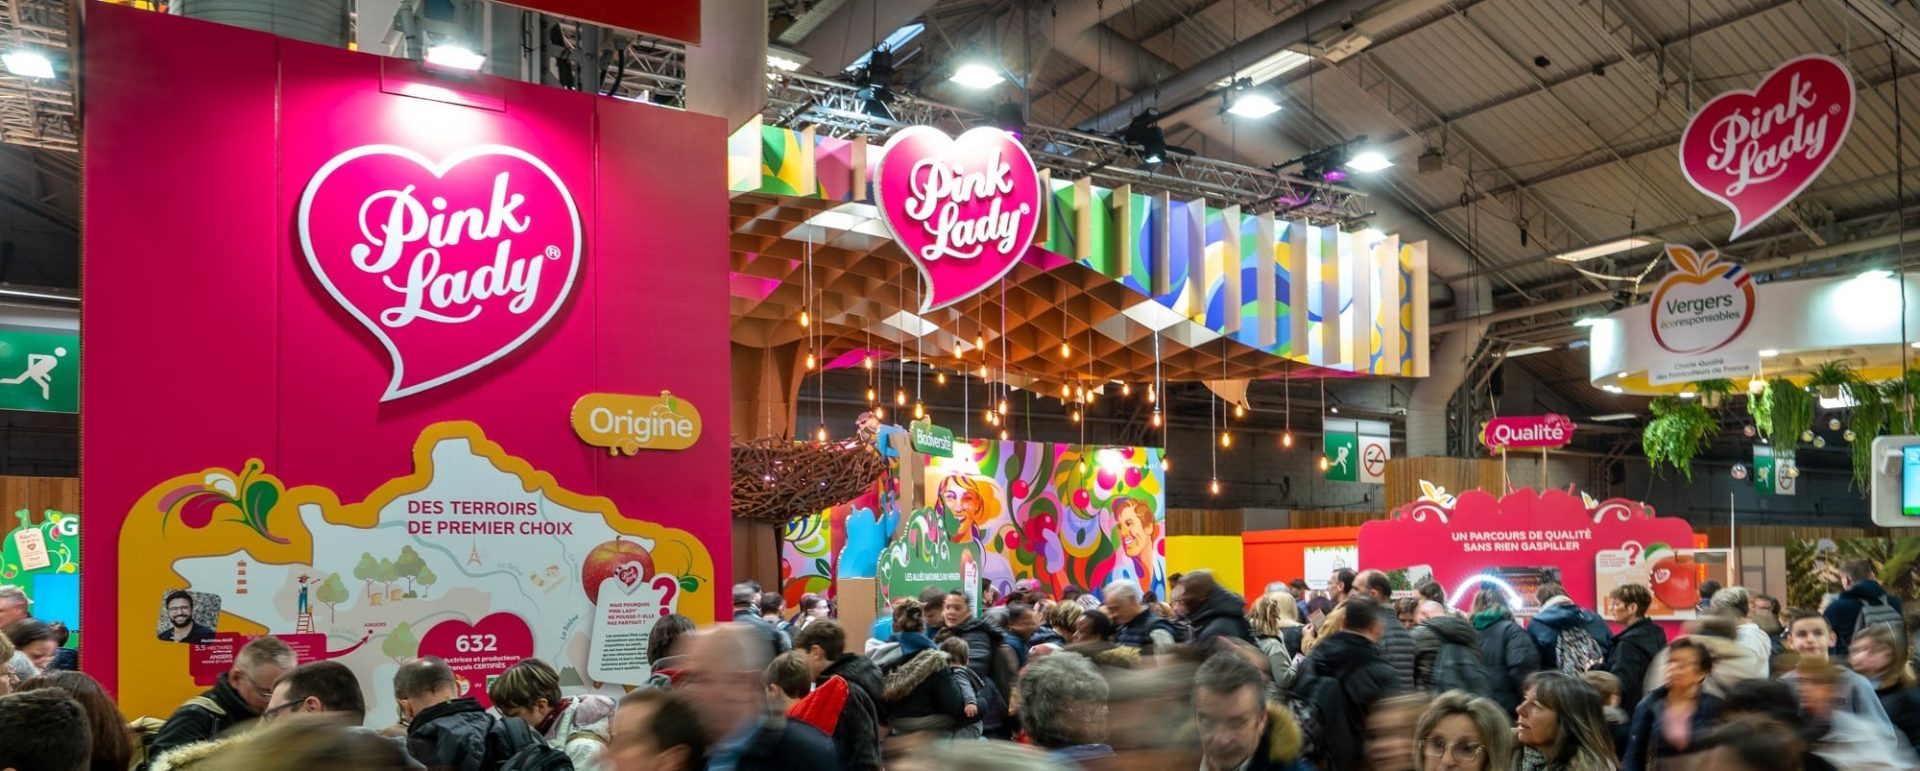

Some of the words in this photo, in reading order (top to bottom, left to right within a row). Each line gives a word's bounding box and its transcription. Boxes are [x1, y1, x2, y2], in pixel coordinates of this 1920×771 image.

[1707, 72, 1817, 170] Pink
[905, 146, 1014, 220] Pink
[351, 171, 531, 273] Pink
[1666, 294, 1733, 315] Vergers
[590, 407, 693, 442] Origine
[1495, 422, 1564, 444] Qualité
[916, 428, 952, 451] Biodiversité
[408, 500, 444, 514] DES
[450, 501, 537, 515] TERROIRS
[408, 520, 432, 535] DE
[437, 520, 515, 535] PREMIER
[519, 521, 573, 535] CHOIX
[1452, 532, 1468, 541] UN
[1470, 531, 1527, 541] PARCOURS
[1529, 531, 1543, 540] DE
[1545, 527, 1592, 540] QUALITÉ
[1463, 542, 1492, 552] SANS
[1494, 542, 1518, 551] RIEN
[1521, 541, 1580, 551] GASPILLER
[455, 634, 497, 652] 632
